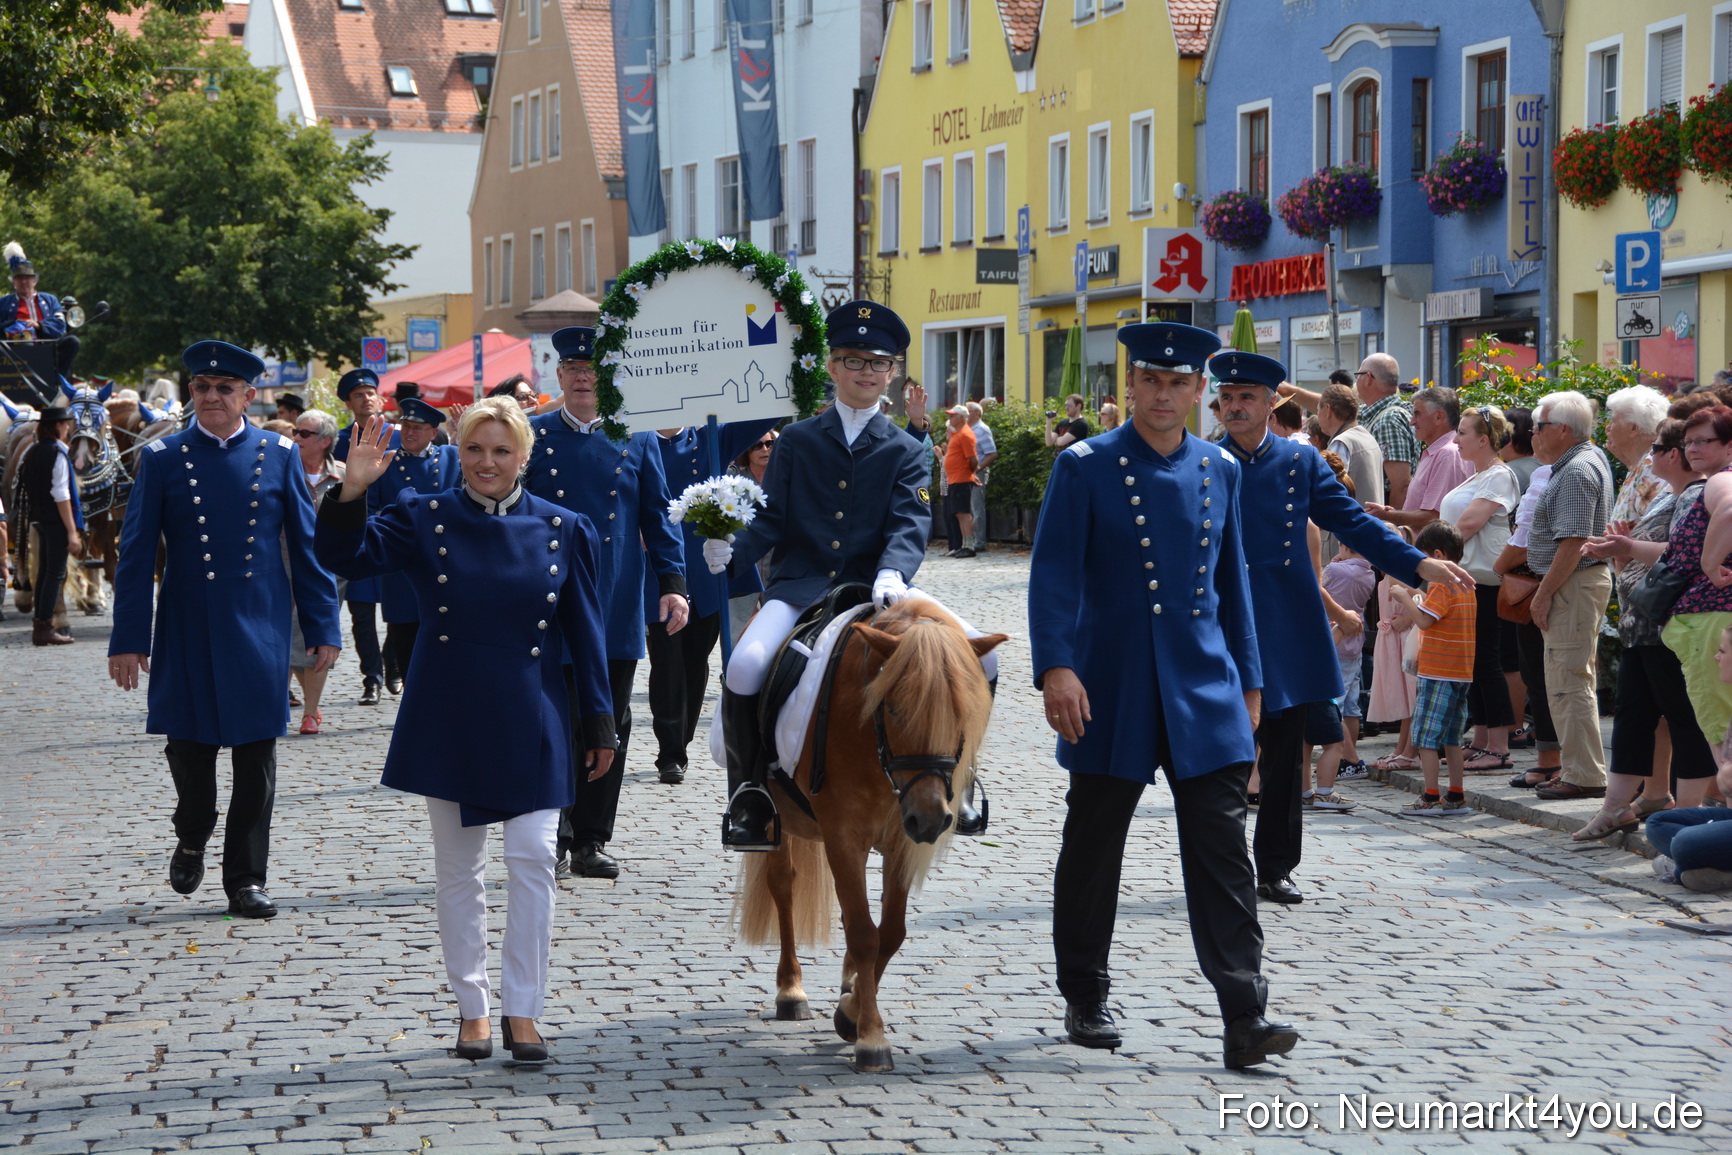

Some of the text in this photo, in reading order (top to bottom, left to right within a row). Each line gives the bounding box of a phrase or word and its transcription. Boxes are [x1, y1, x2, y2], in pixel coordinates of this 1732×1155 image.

[623, 48, 655, 134] K&L
[1516, 97, 1543, 121] CAFÉ
[933, 99, 1024, 146] HOTEL Lehmeier
[1517, 127, 1539, 245] WITTL
[979, 269, 1019, 280] TAIFU
[1626, 240, 1651, 286] P
[1228, 253, 1327, 302] APOTHEKE
[928, 288, 982, 313] Restaurant
[1630, 301, 1645, 311] nur
[693, 320, 718, 334] für
[622, 337, 744, 360] Kommunikation
[623, 361, 700, 379] Nürnberg
